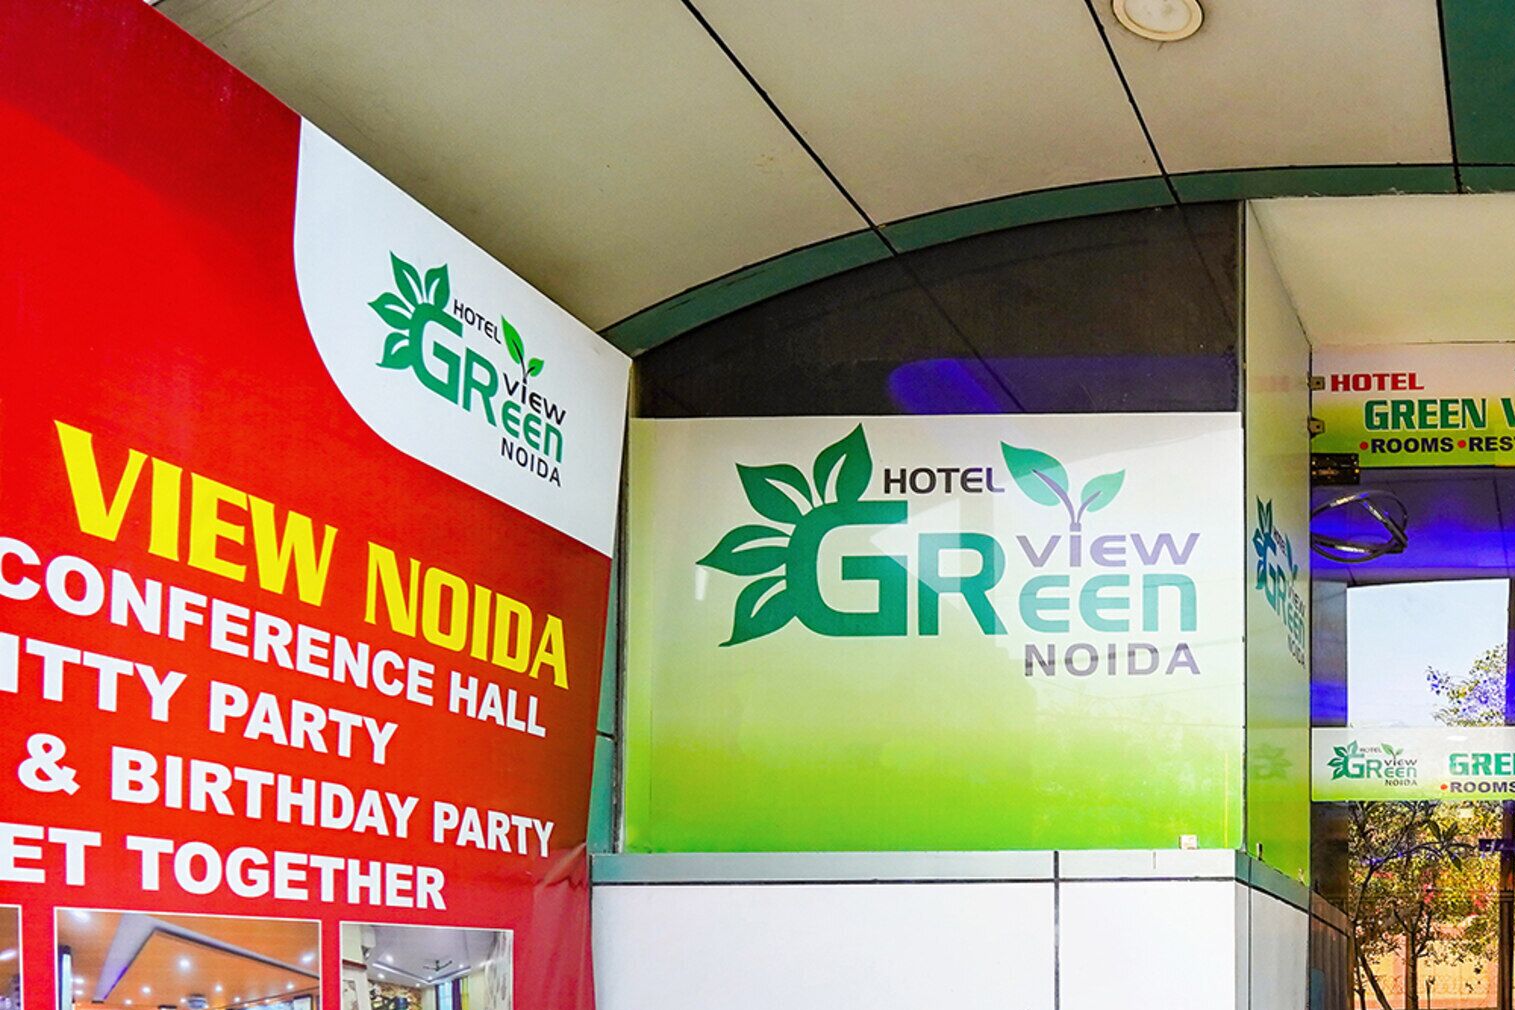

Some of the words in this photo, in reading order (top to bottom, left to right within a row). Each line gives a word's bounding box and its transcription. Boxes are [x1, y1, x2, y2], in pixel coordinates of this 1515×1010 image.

[453, 299, 502, 345] HOTEL
[1330, 373, 1425, 392] HOTEL
[1364, 398, 1487, 431] GREEN
[501, 437, 562, 487] NOIDA
[1371, 437, 1454, 454] ROOMS
[883, 467, 1005, 495] HOTEL
[54, 420, 338, 607] VIEW
[365, 541, 570, 690] NOIDA
[0, 536, 435, 706] CONFERENCE
[448, 671, 547, 737] HALL
[1024, 642, 1201, 677] NOIDA
[208, 681, 398, 765] PARTY
[17, 732, 80, 796] &
[110, 745, 419, 839] BIRTHDAY
[432, 800, 555, 858] PARTY
[126, 835, 447, 911] TOGETHER
